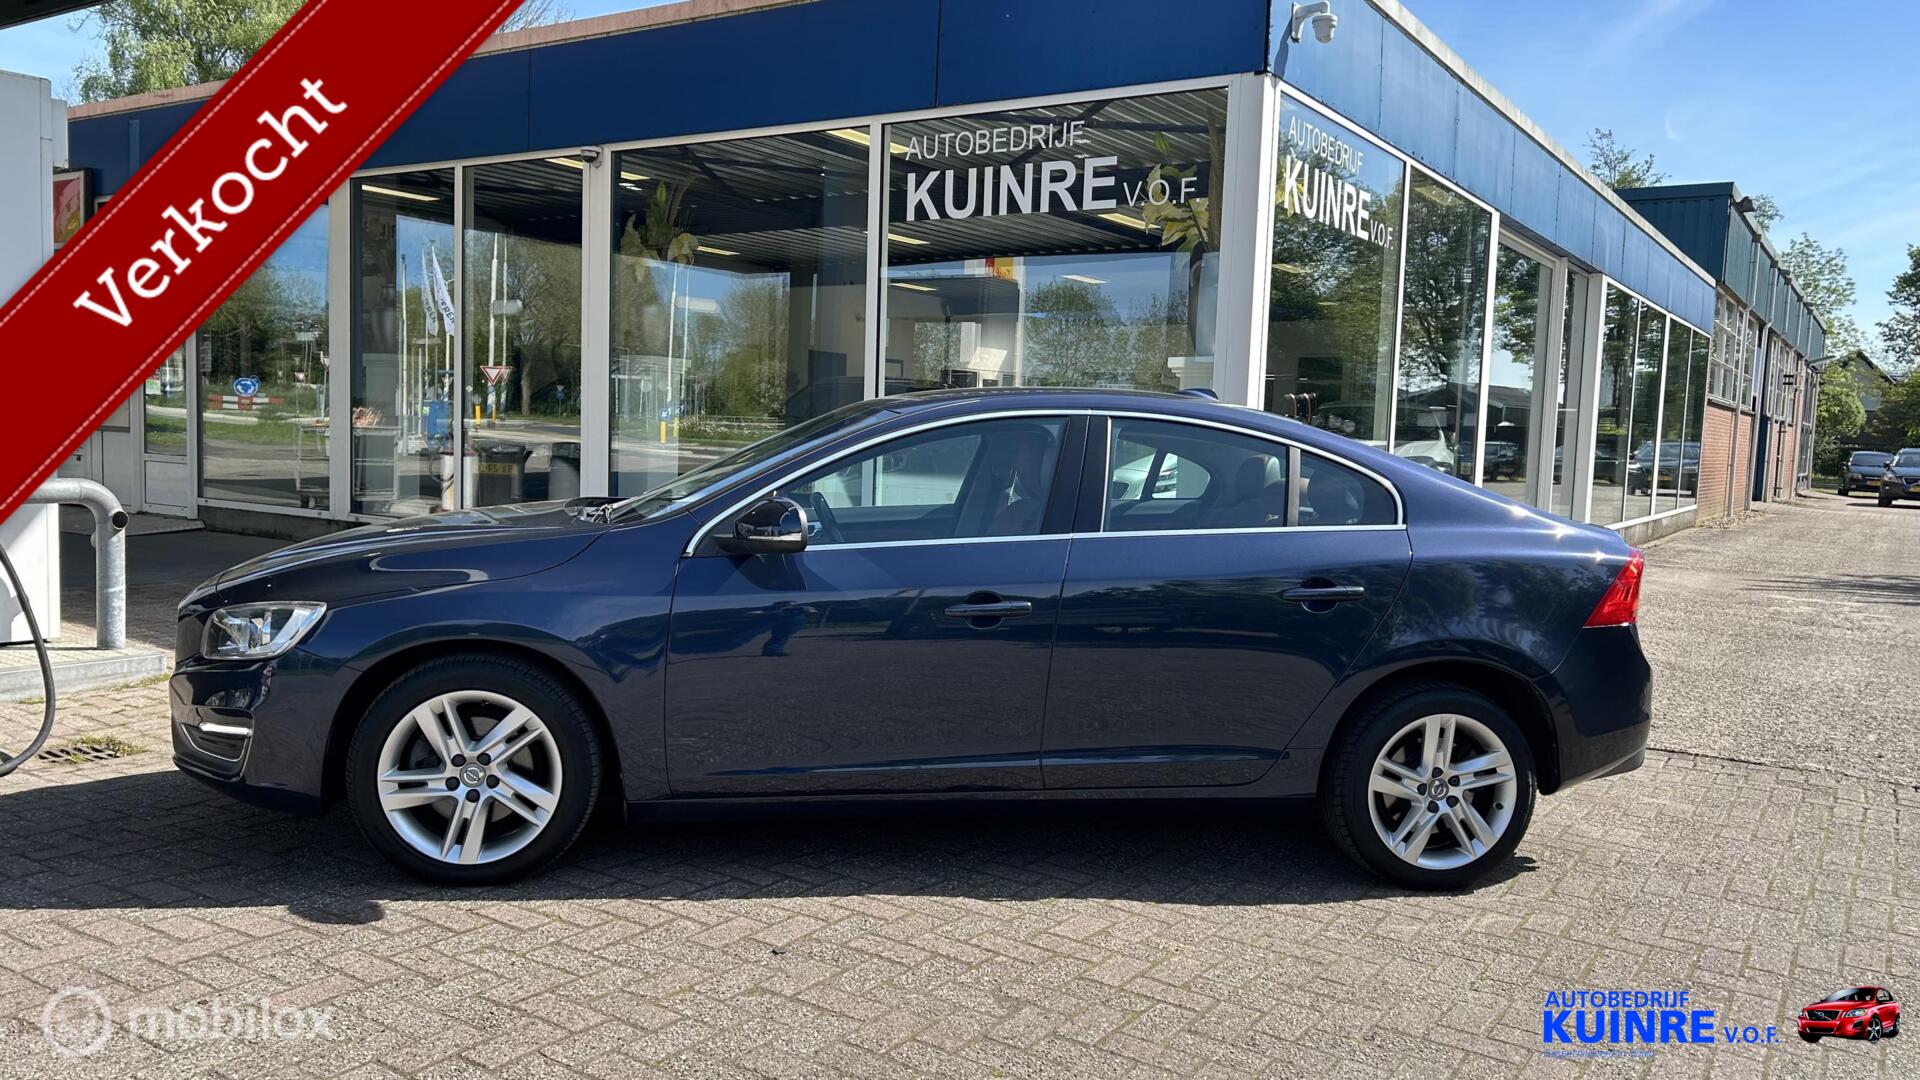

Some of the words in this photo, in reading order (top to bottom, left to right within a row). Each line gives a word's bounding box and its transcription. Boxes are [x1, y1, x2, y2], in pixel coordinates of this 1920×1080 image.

[905, 120, 1086, 160] AUTOBEDRIJF
[1288, 116, 1364, 174] AUTOBEDRIJF
[906, 156, 1118, 222] KUINRE
[1123, 176, 1202, 207] V.O.F.
[1283, 155, 1371, 241] KUINRE
[1370, 219, 1394, 250] V.O.F.
